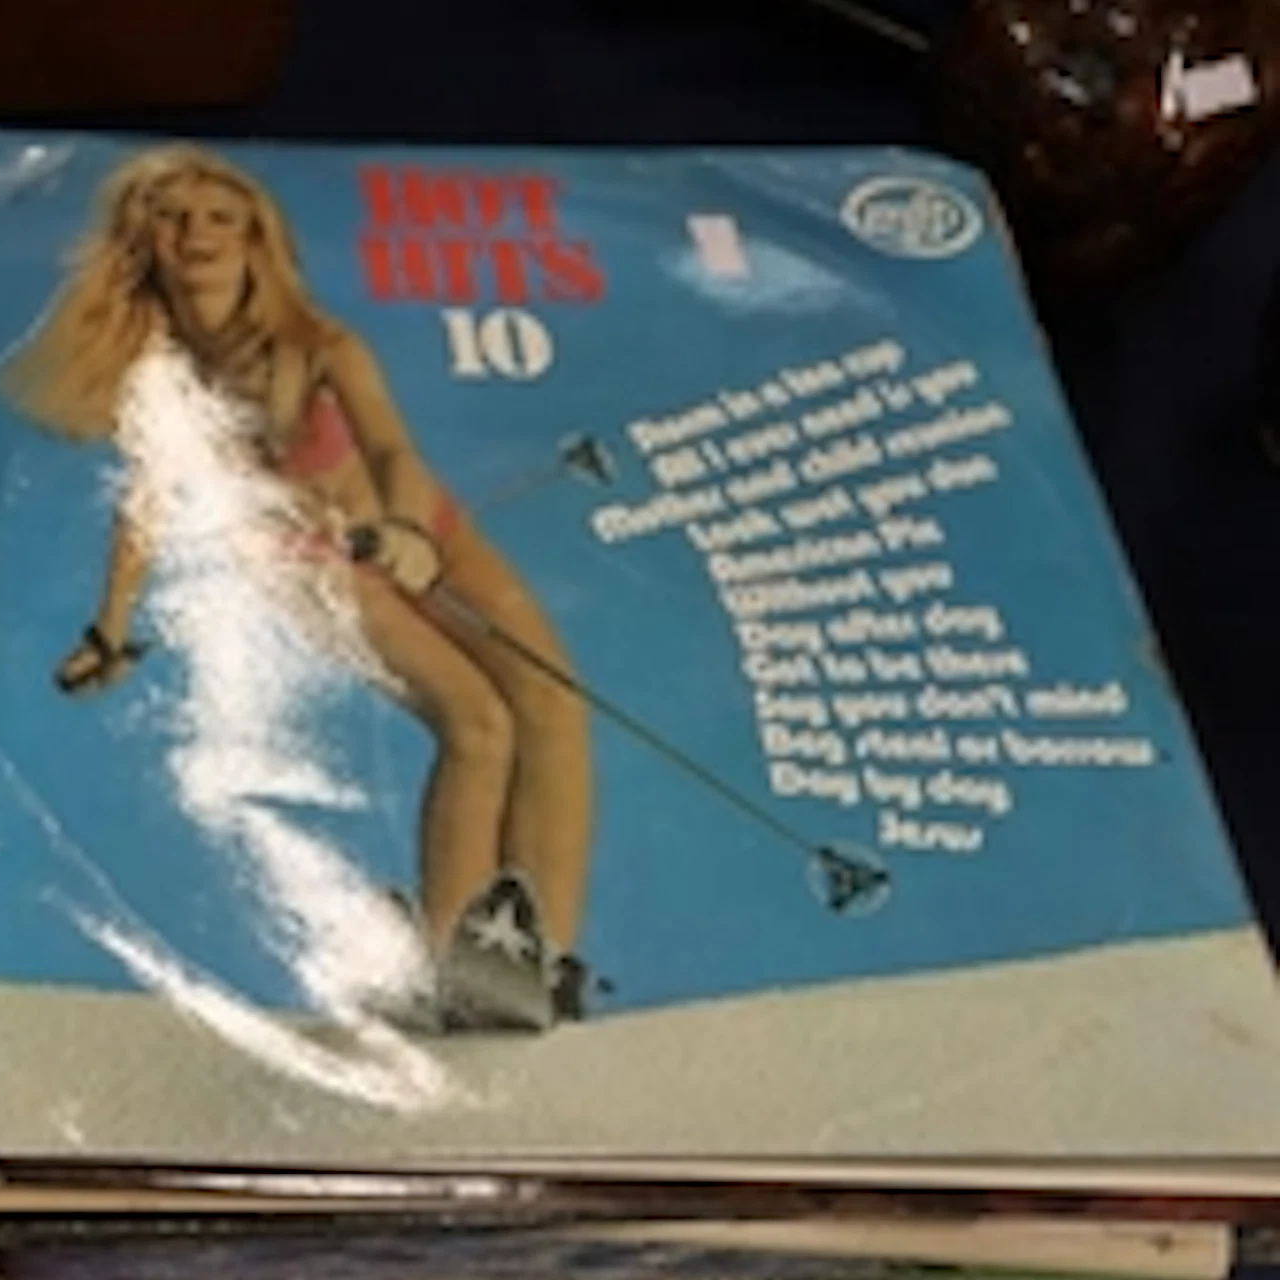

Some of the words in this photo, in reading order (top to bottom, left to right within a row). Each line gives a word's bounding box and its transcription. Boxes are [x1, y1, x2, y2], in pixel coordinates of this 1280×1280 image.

[357, 163, 562, 231] HOT
[358, 233, 606, 305] HITS
[442, 308, 555, 380] 10
[801, 392, 883, 435] need
[912, 361, 978, 404] you
[726, 461, 796, 503] and
[799, 436, 883, 483] child
[856, 474, 927, 517] you
[879, 563, 952, 602] you
[737, 621, 823, 654] Day
[827, 610, 915, 645] after
[924, 602, 1004, 641] day
[832, 694, 908, 727] you
[1026, 682, 1128, 716] mind
[769, 761, 860, 806] Day
[924, 771, 1012, 815] day
